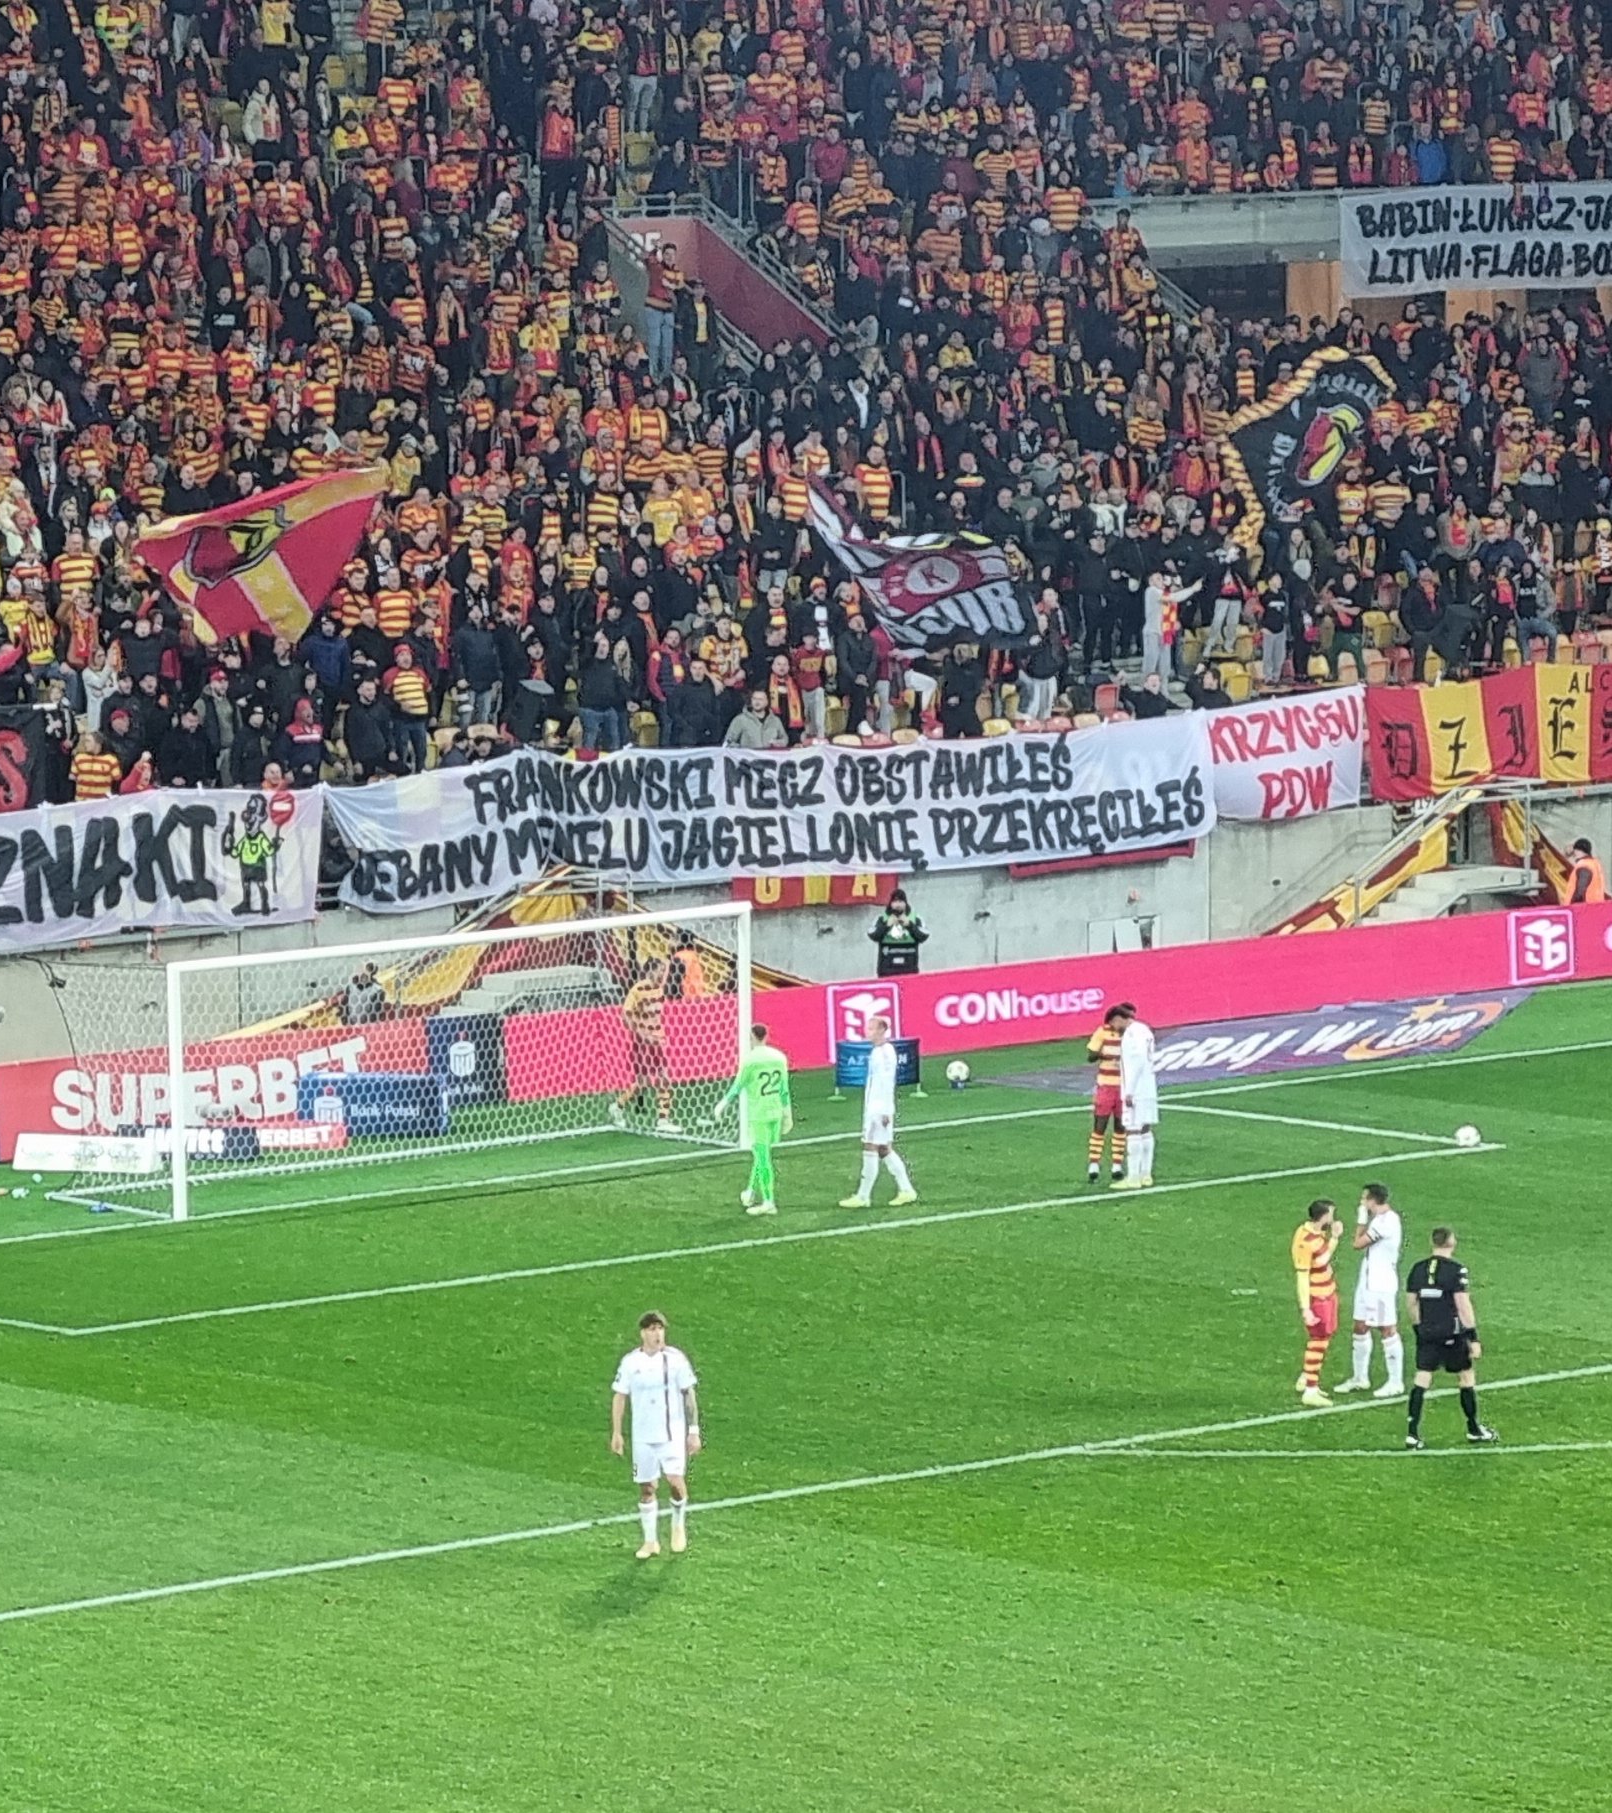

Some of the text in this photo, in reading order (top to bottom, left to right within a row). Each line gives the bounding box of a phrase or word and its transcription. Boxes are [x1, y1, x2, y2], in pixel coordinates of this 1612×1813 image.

[1356, 197, 1451, 238] BABIN
[1367, 240, 1612, 285] LITWA FLAGA BO
[464, 757, 715, 825] FRANKOWSKI
[835, 733, 1073, 805] OBSTAWIŁEŚ
[1257, 760, 1333, 819] PDW
[934, 987, 1105, 1027] CONhouse
[1293, 1018, 1378, 1056] W
[51, 1035, 367, 1133] SUPERBET
[758, 1070, 781, 1096] 22
[259, 1125, 332, 1149] ERBET
